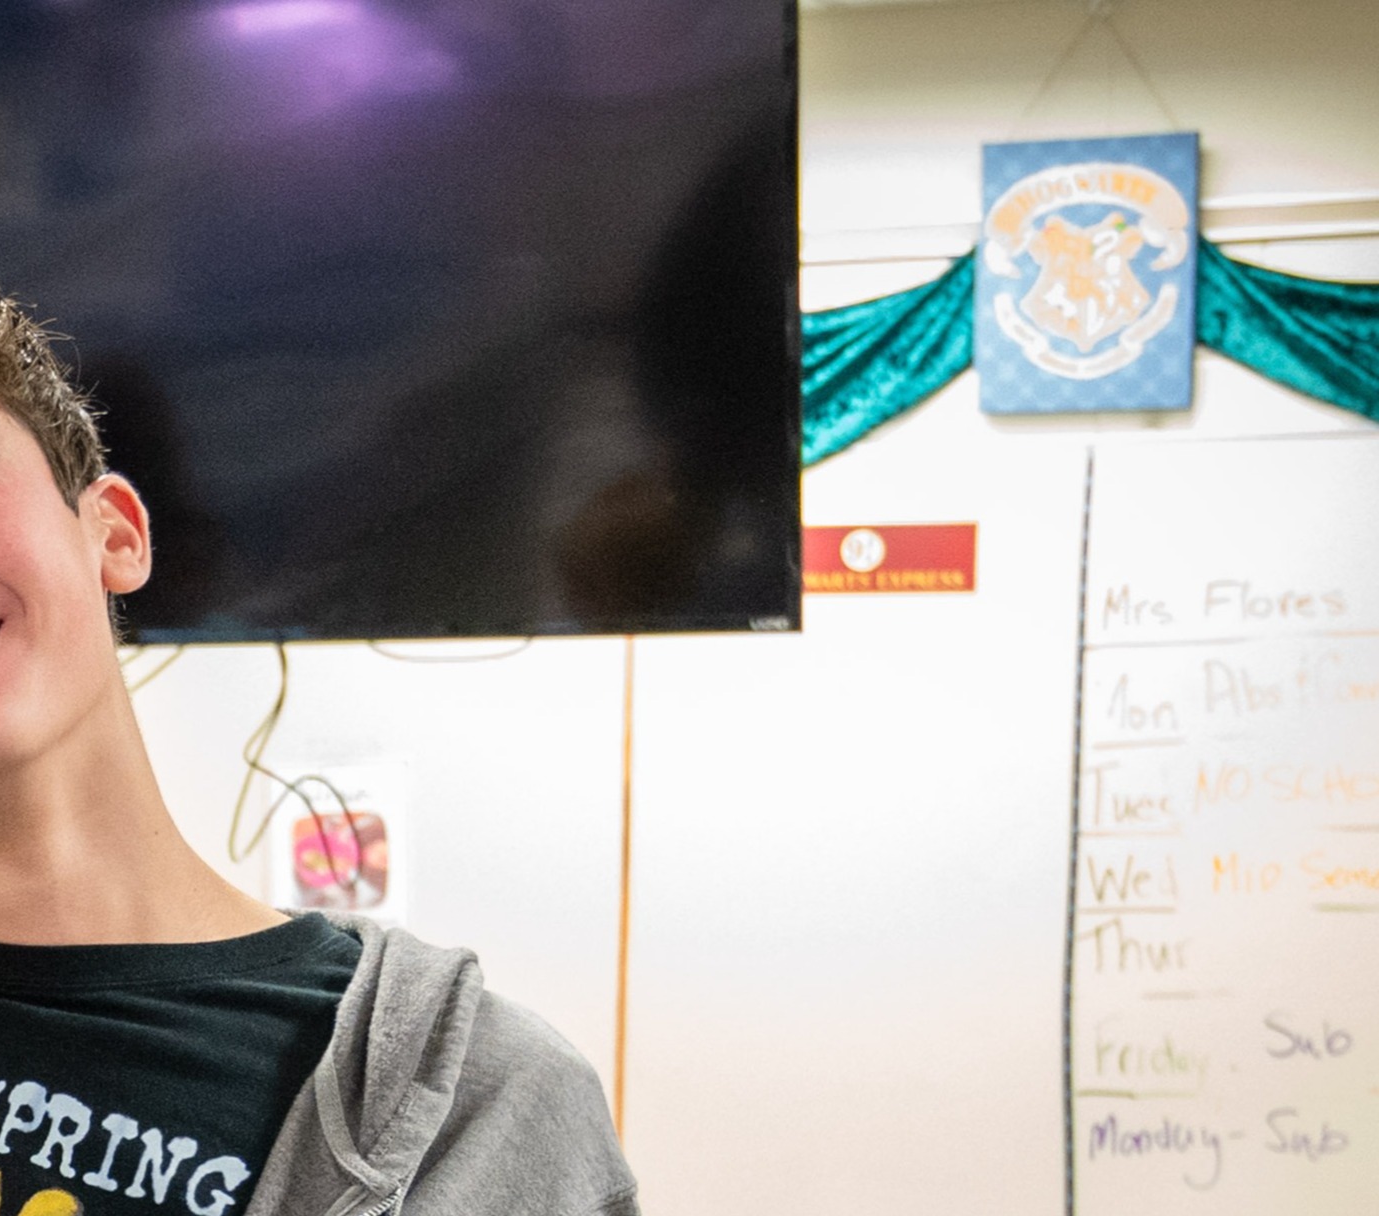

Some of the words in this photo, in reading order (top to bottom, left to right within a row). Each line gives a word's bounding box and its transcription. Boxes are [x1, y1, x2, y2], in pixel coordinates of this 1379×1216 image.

[1102, 583, 1174, 630] Mrs
[1203, 579, 1348, 621] Flores
[1262, 1008, 1356, 1062] Sub
